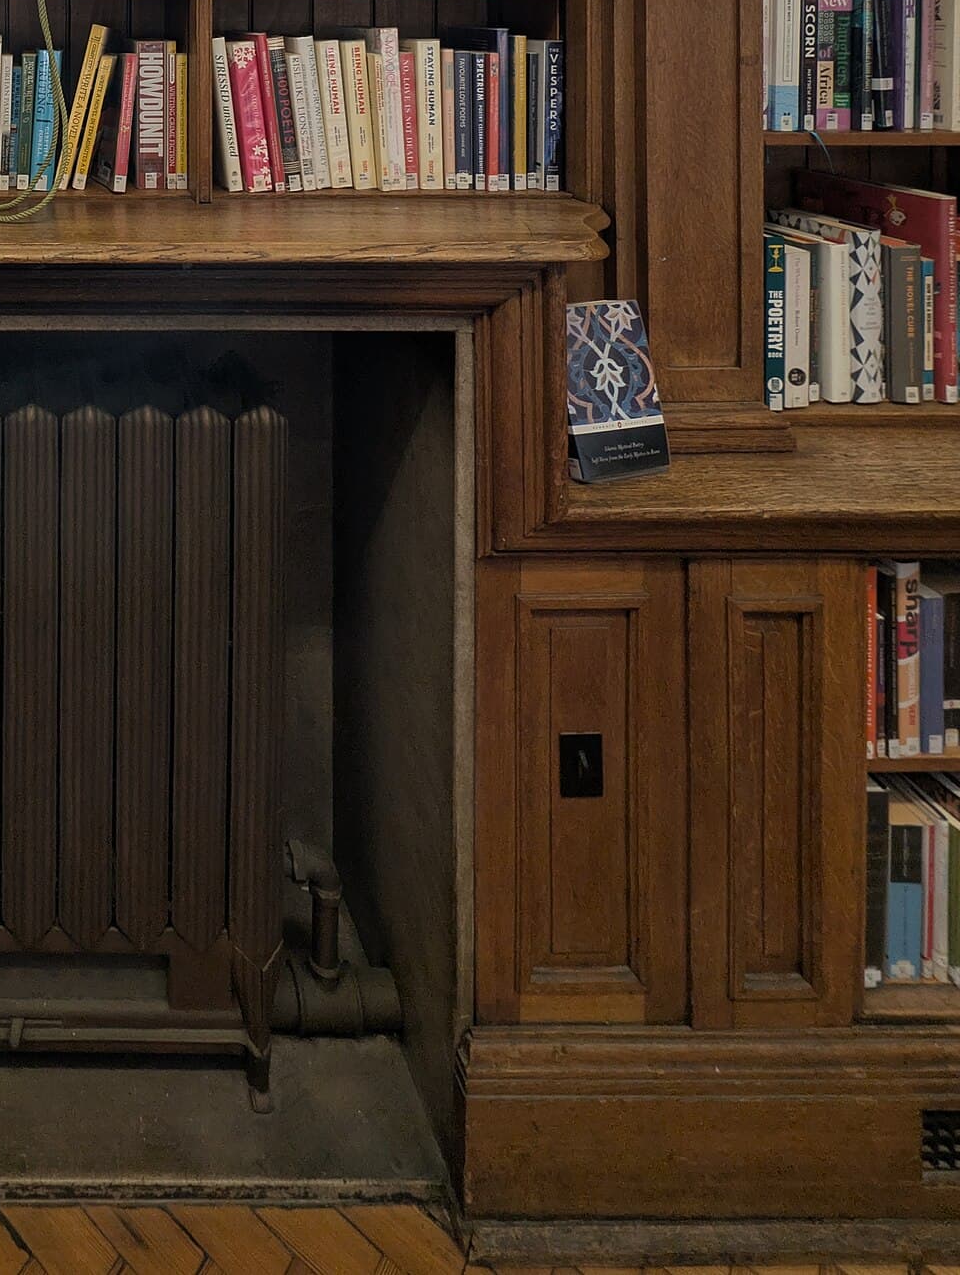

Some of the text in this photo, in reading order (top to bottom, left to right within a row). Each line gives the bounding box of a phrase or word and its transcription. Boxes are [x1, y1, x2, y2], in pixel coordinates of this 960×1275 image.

[307, 44, 316, 76] POEMS
[805, 5, 816, 58] SCORN
[835, 16, 850, 86] Daughters
[36, 61, 47, 114] WRITING
[139, 53, 163, 157] HOWDUNIT
[215, 54, 238, 157] STRESSED unstressed
[278, 76, 294, 144] 100 POETS
[291, 57, 307, 135] RISE LIKE LIONS
[327, 47, 340, 114] BEING HUMAN
[357, 79, 365, 114] HUMAN
[819, 63, 831, 105] Africa
[900, 579, 919, 657] sharp
